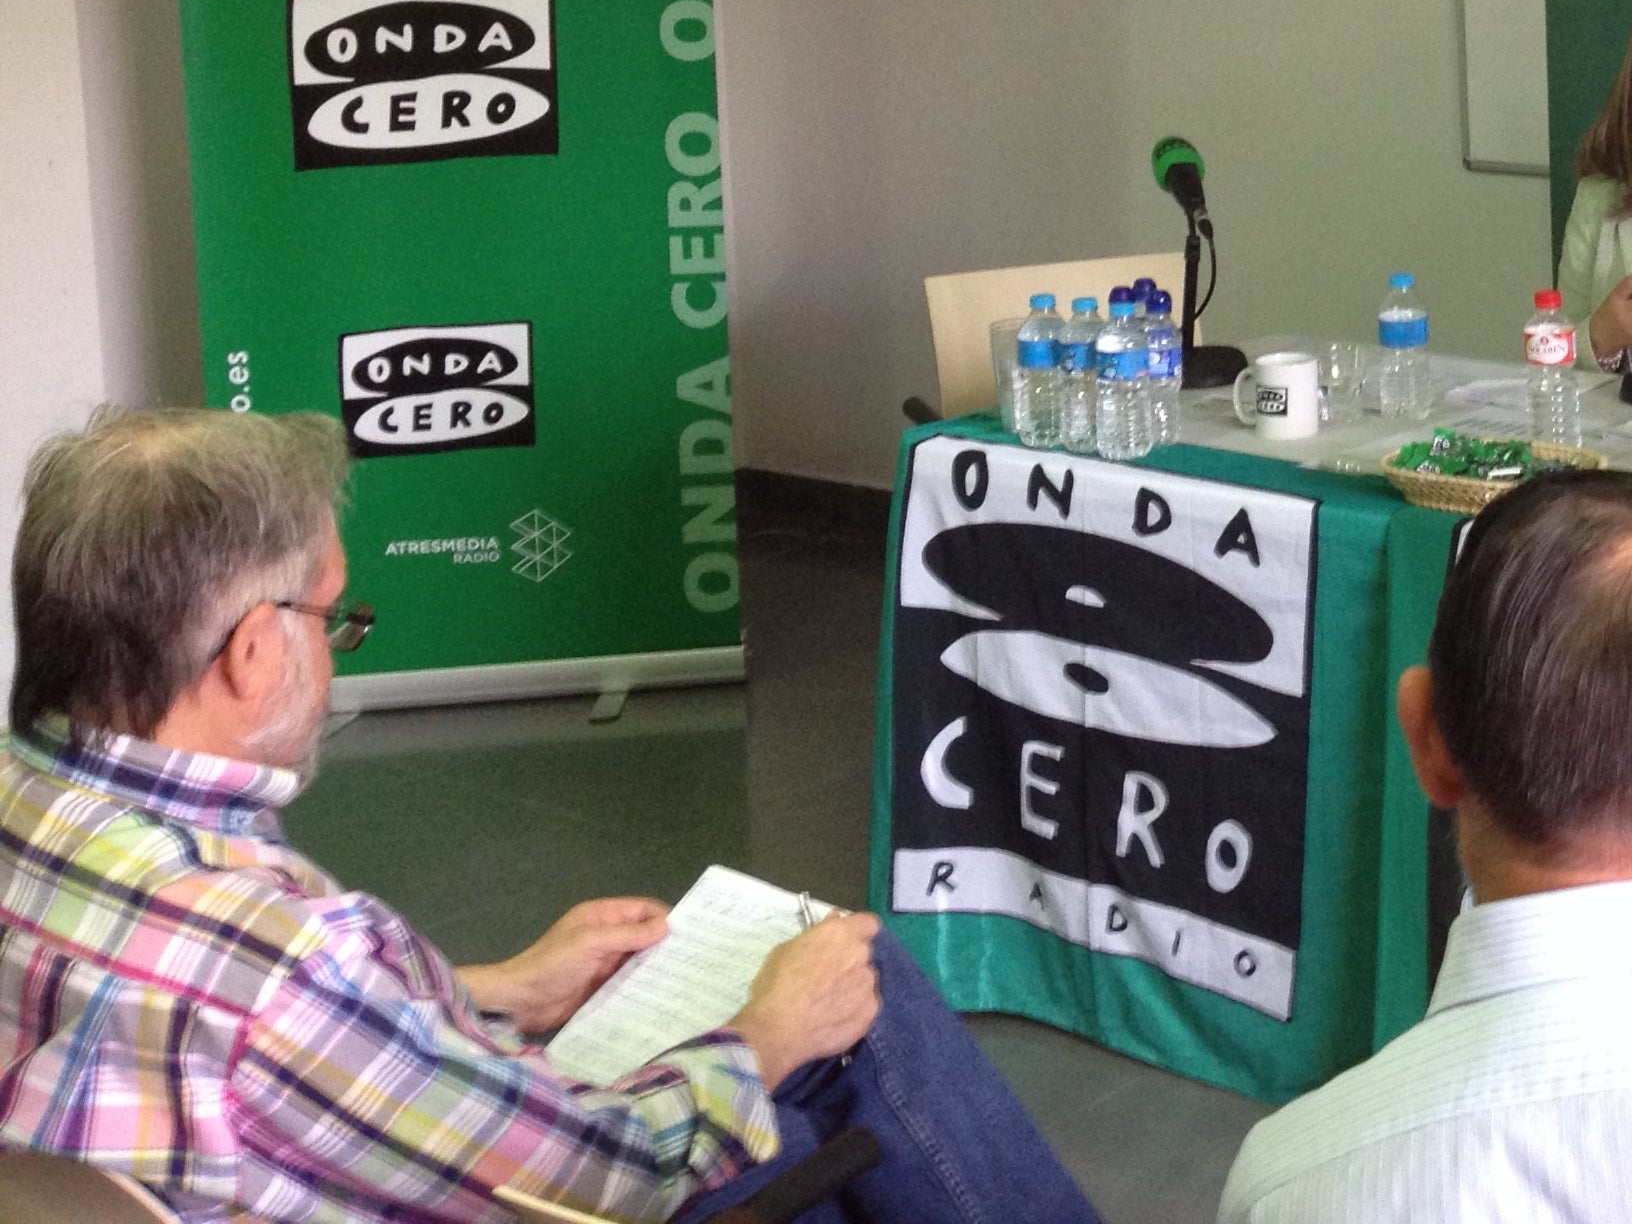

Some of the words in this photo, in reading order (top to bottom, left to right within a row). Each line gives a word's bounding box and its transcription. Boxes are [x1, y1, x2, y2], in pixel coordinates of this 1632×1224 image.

[326, 22, 513, 62] ONDA
[341, 90, 517, 133] CERO
[664, 112, 729, 329] CERO
[367, 351, 503, 383] ONDA
[379, 401, 504, 433] CERO
[677, 362, 740, 612] ONDA
[951, 450, 1261, 568] ONDA
[385, 536, 499, 556] ATRESMEDIA
[453, 551, 500, 564] RADIO
[920, 716, 1253, 893] CERO
[926, 860, 1257, 978] RADIO
